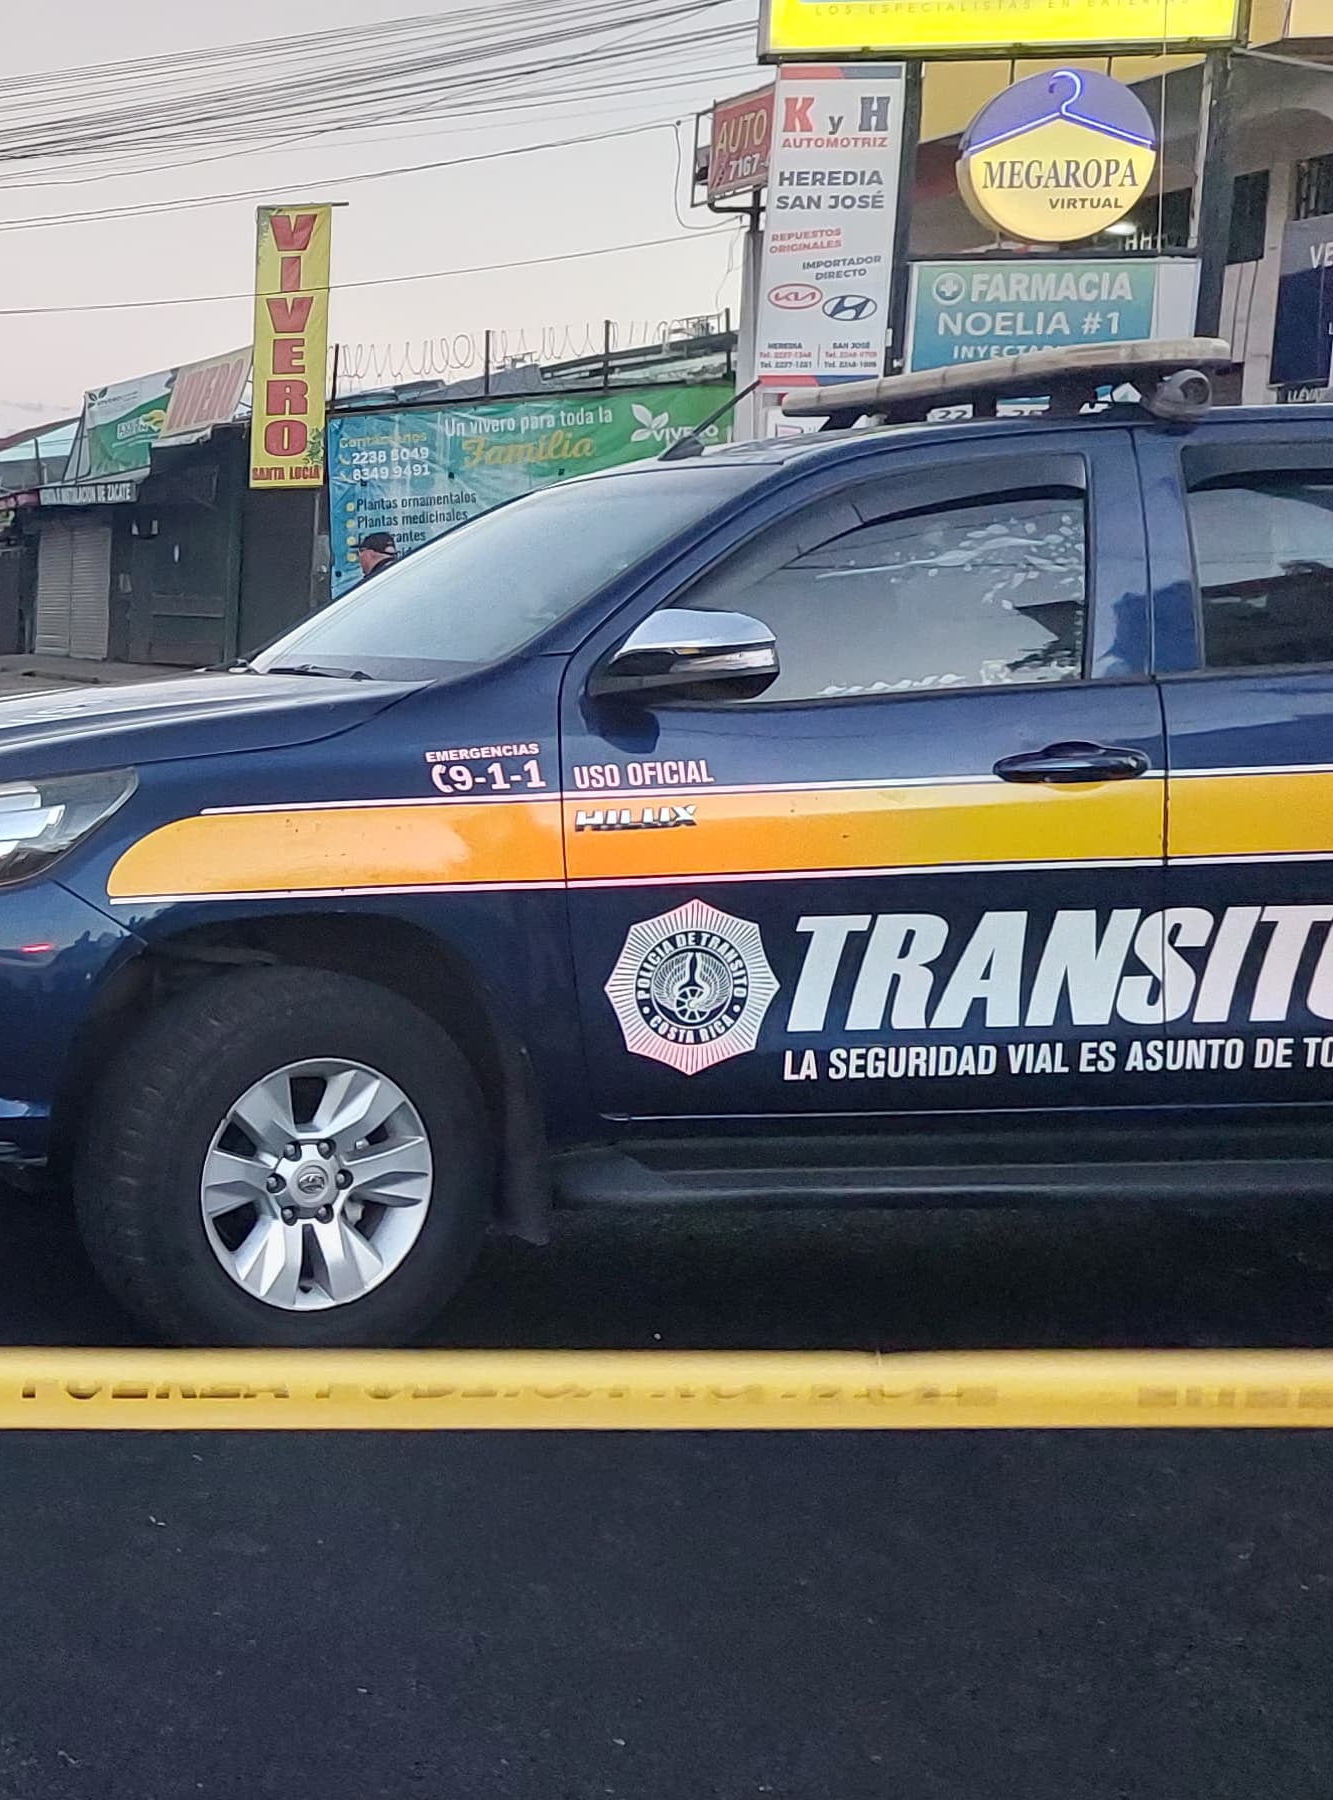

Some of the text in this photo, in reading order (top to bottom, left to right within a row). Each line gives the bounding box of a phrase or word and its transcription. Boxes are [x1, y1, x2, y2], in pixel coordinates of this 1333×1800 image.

[783, 97, 815, 132] K
[858, 96, 890, 132] H
[715, 108, 768, 155] AUTO
[783, 137, 888, 149] AUTOMOTRIZ
[778, 170, 883, 187] HEREDIA
[982, 158, 1138, 189] MEGAROPA
[776, 191, 884, 210] SAN JOSÉ
[1049, 197, 1123, 209] VIRTUAL
[769, 239, 841, 254] ORIGINALES
[771, 228, 841, 242] REPUESTOS
[802, 255, 882, 270] IMPORTADOR
[815, 268, 867, 281] DIRECTO
[971, 271, 1133, 302] FARMACIA
[938, 311, 1120, 336] NOELIA #1
[264, 214, 318, 457] VIVERO
[445, 405, 613, 437] Un vivero para toda la
[653, 424, 719, 442] VIVEO
[462, 429, 595, 468] Familia
[251, 467, 285, 481] SANTA
[393, 463, 431, 478] 9491
[356, 498, 398, 512] Plantas
[357, 508, 469, 529] Plantas medicinales
[425, 743, 539, 763] EMERGENCIAS
[573, 759, 714, 789] USO OFICIAL
[575, 804, 698, 832] HILUX
[637, 931, 748, 1000] POLICIA DE TRANSITO
[786, 904, 1333, 1032] TRANSIT
[649, 1014, 735, 1044] COSTA RICA
[783, 1049, 818, 1081] LA
[828, 1044, 997, 1080] SEGURIDAD
[1007, 1042, 1069, 1075] VIAL
[1078, 1039, 1117, 1073] ES
[1124, 1037, 1244, 1072] ASUNTO
[1253, 1037, 1293, 1069] DE
